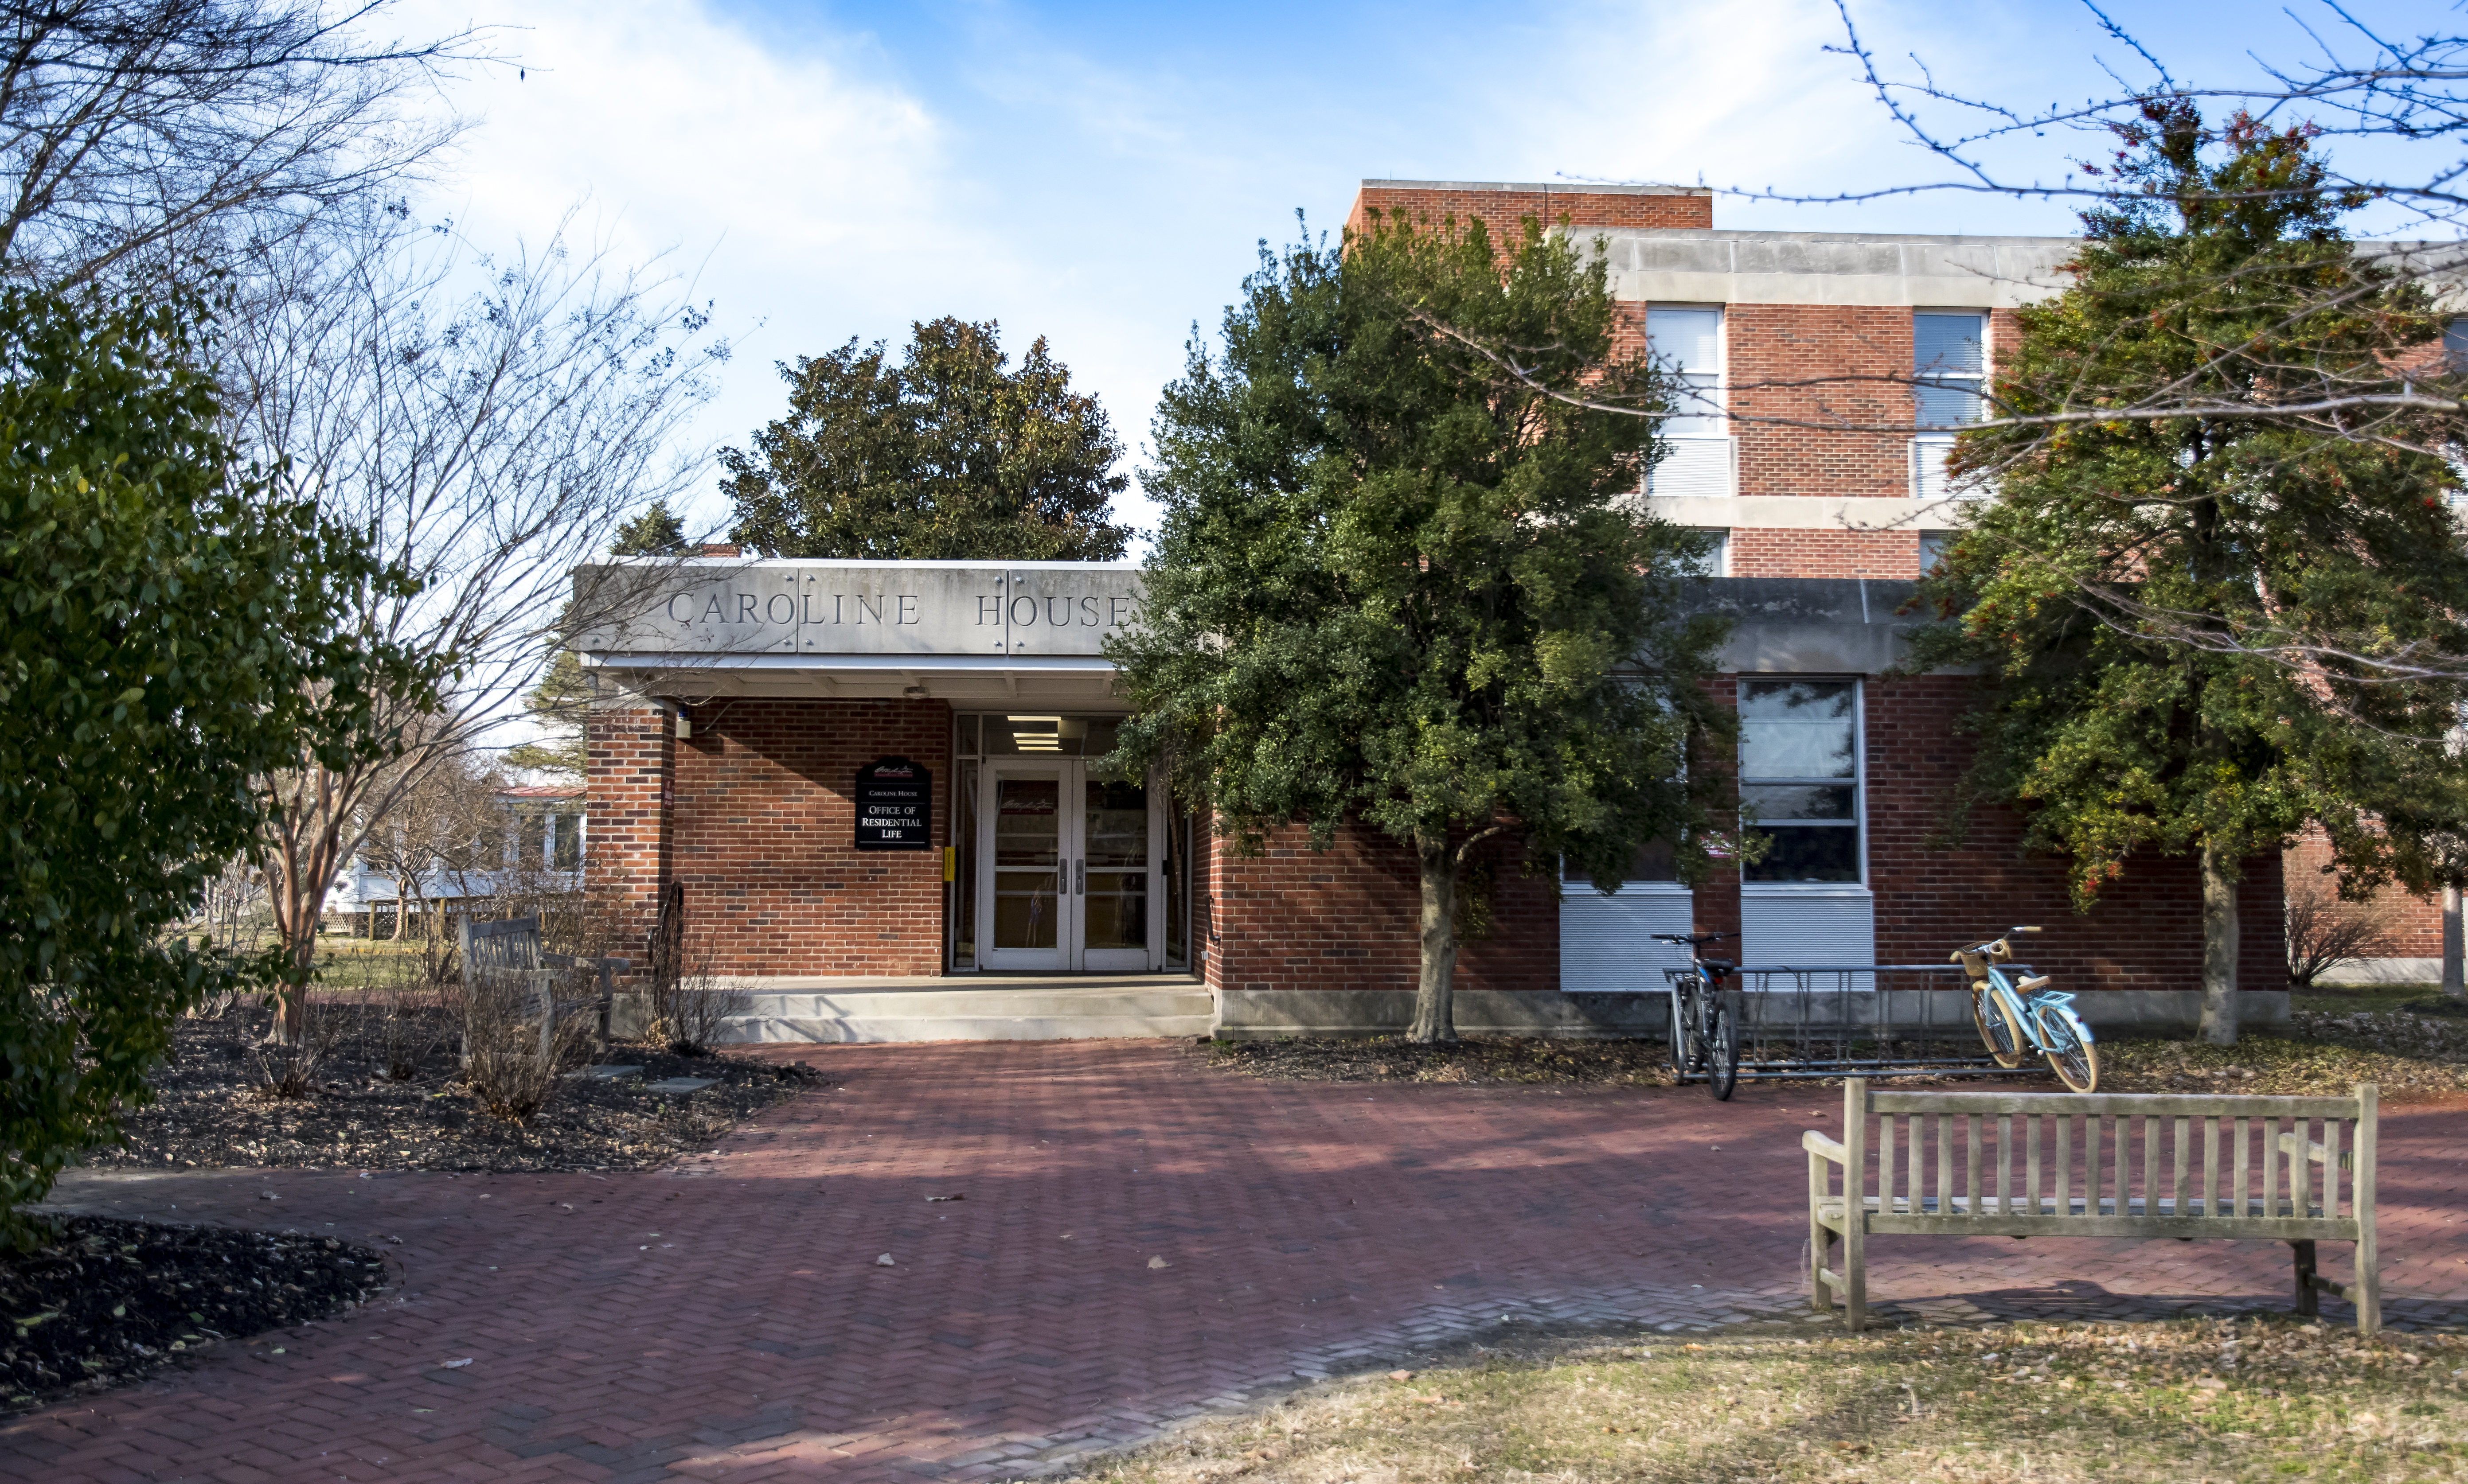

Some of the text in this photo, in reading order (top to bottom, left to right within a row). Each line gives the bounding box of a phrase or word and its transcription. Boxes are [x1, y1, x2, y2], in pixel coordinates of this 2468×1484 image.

[668, 592, 1132, 627] CAROLINE HOUSE
[869, 806, 900, 814] OFFICE
[862, 818, 922, 826] RESIDENTIAL
[882, 829, 902, 838] LIFE
